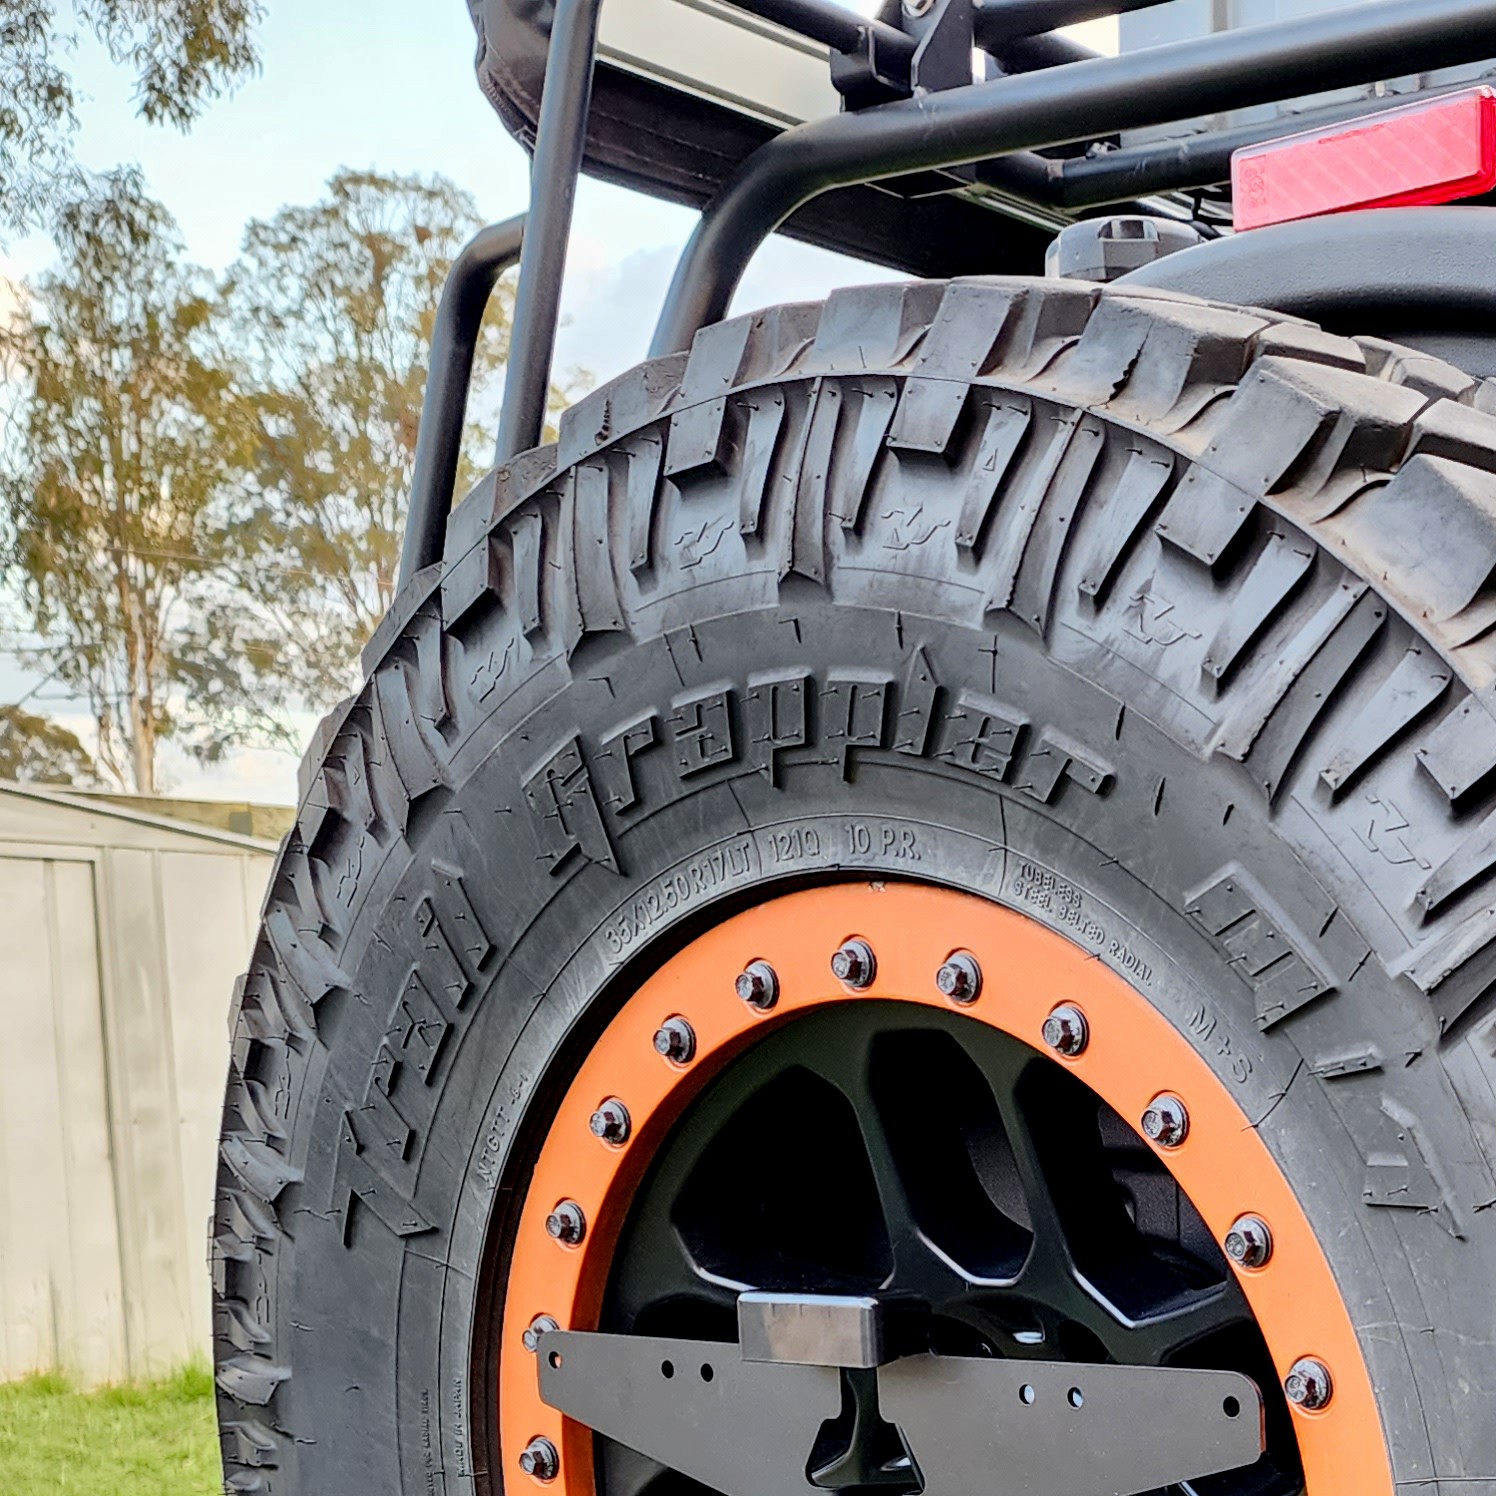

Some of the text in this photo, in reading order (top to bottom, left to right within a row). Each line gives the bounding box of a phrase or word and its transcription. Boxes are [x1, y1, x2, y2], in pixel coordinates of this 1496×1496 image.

[847, 822, 872, 856] 10
[1019, 860, 1083, 909] TUBELESS
[331, 858, 497, 1249] Trail
[520, 643, 1115, 877] Grappler
[1013, 880, 1153, 987] STEEL BELTED RADIAL
